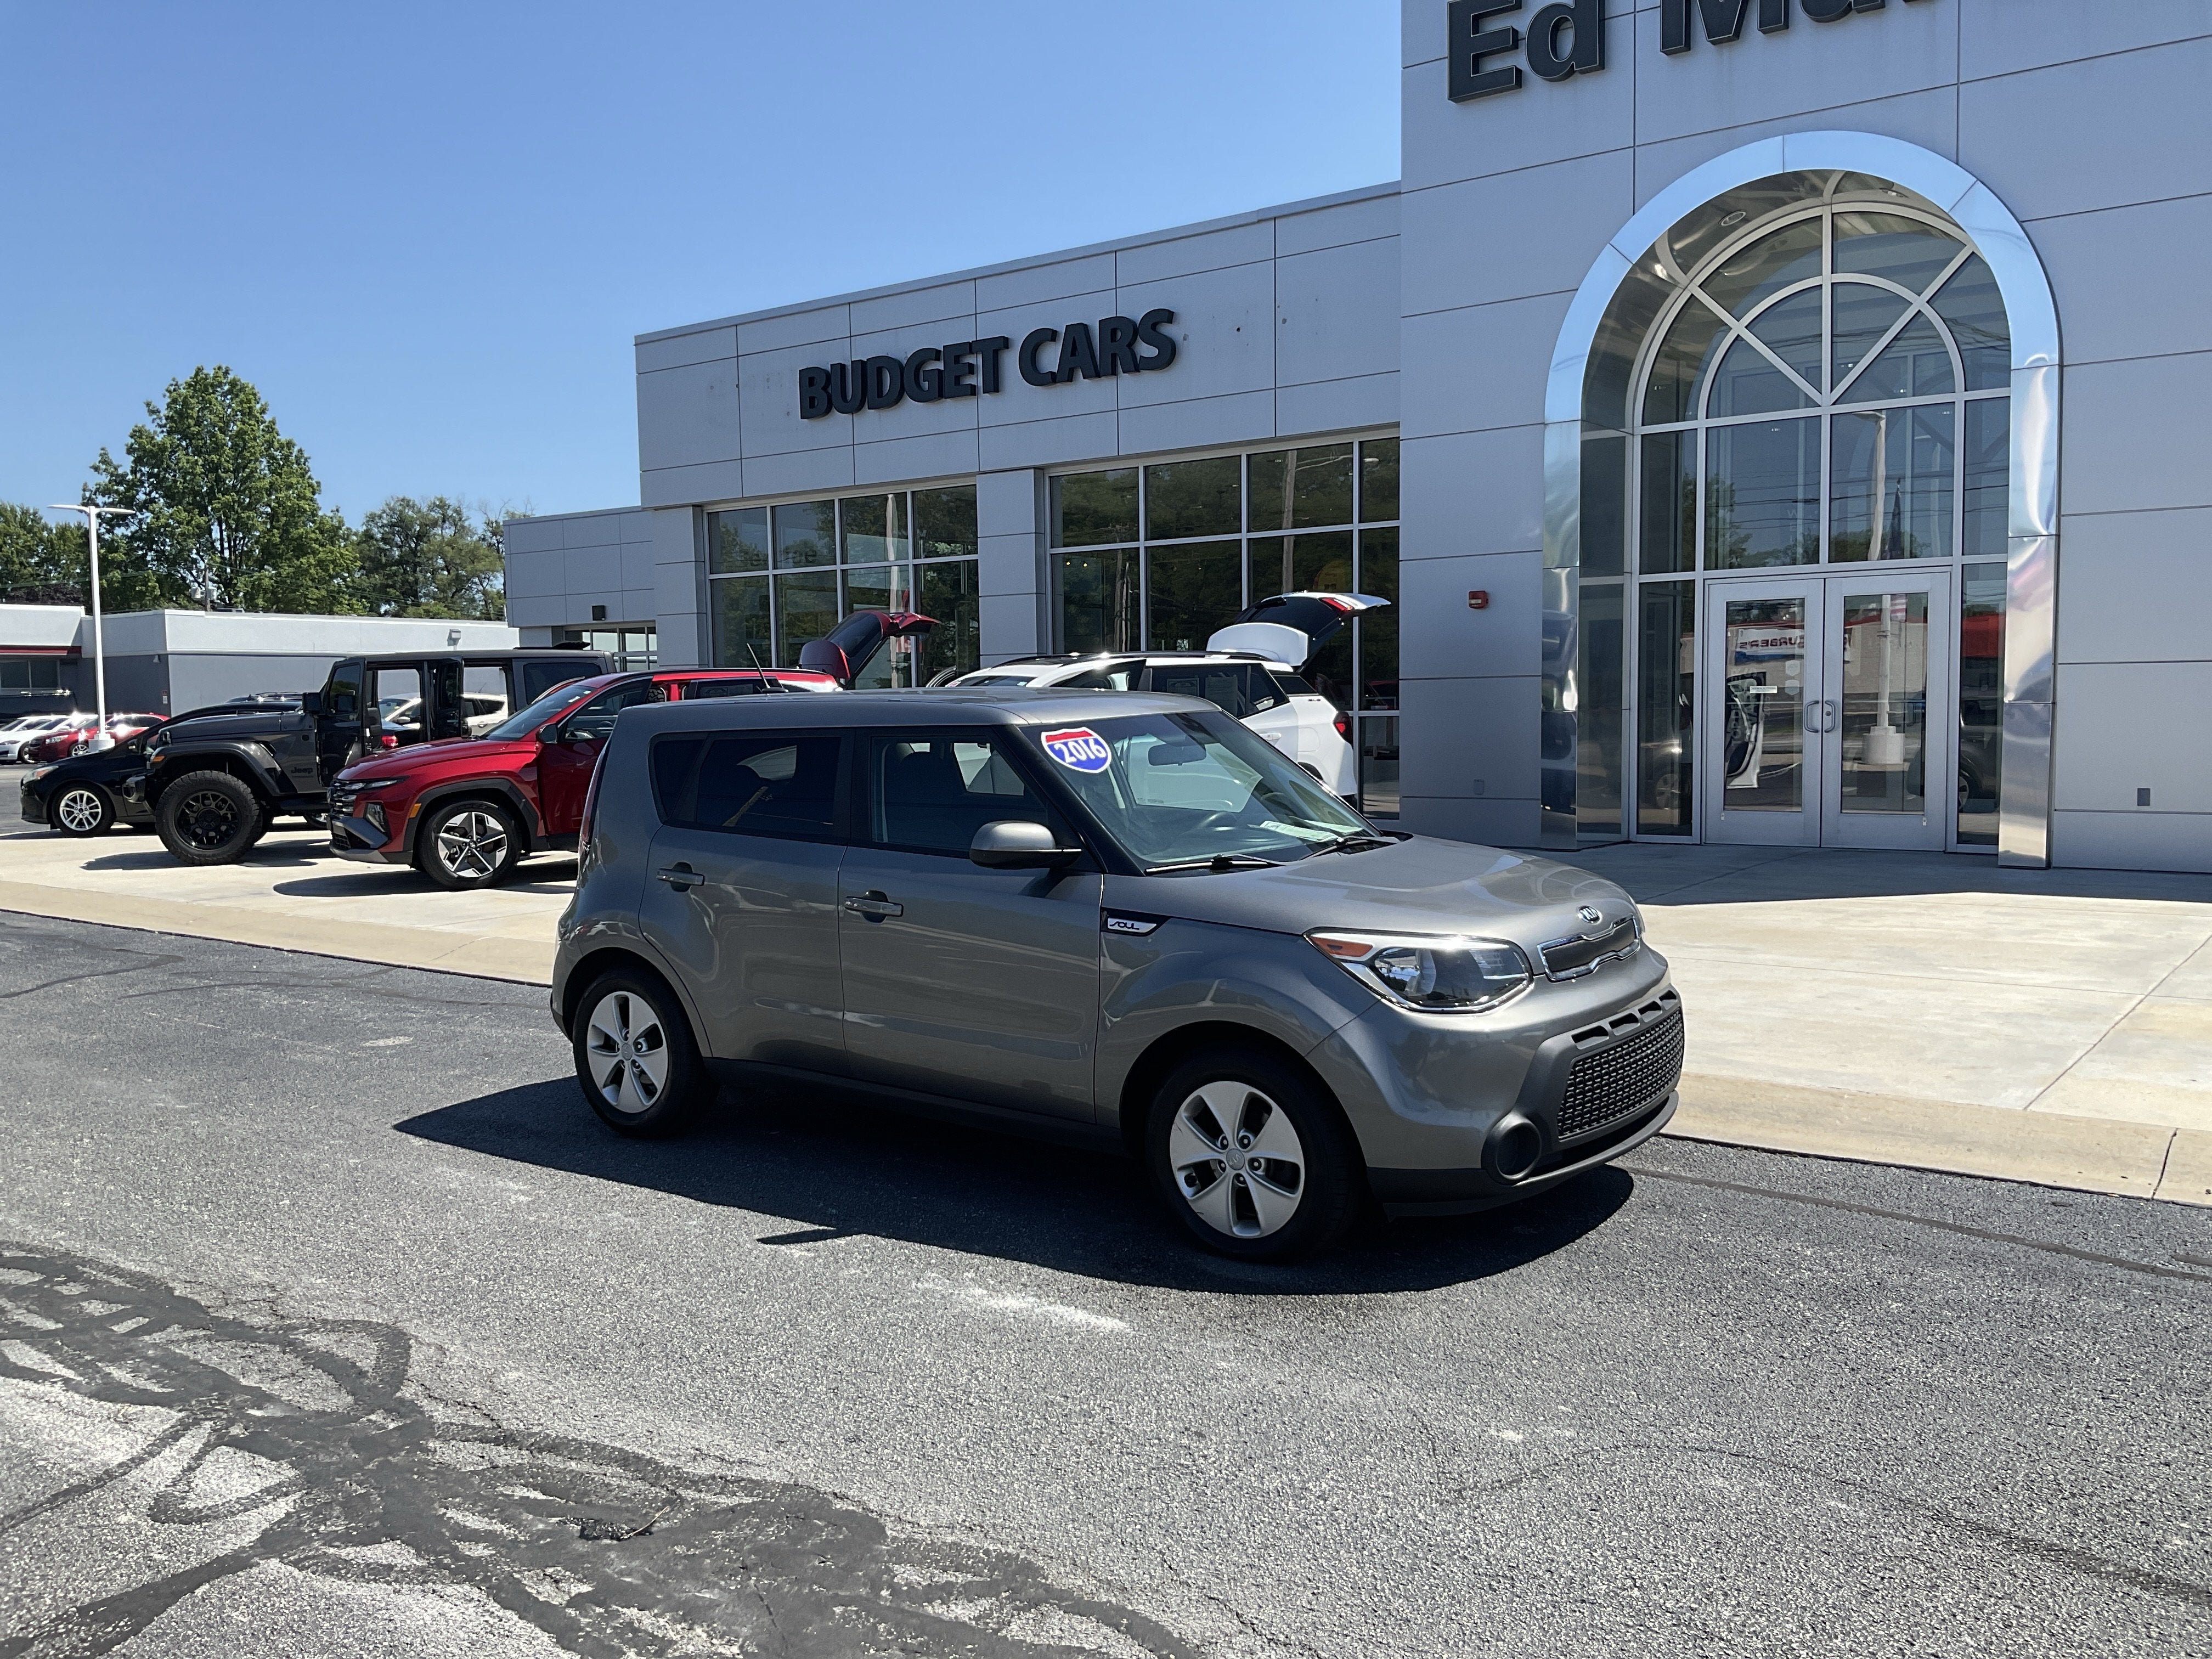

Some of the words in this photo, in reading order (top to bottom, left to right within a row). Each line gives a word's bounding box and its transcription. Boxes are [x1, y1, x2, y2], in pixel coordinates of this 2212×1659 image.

[799, 335, 1009, 420] BUDGET
[1018, 308, 1177, 387] CARS
[1054, 738, 1107, 763] 2016
